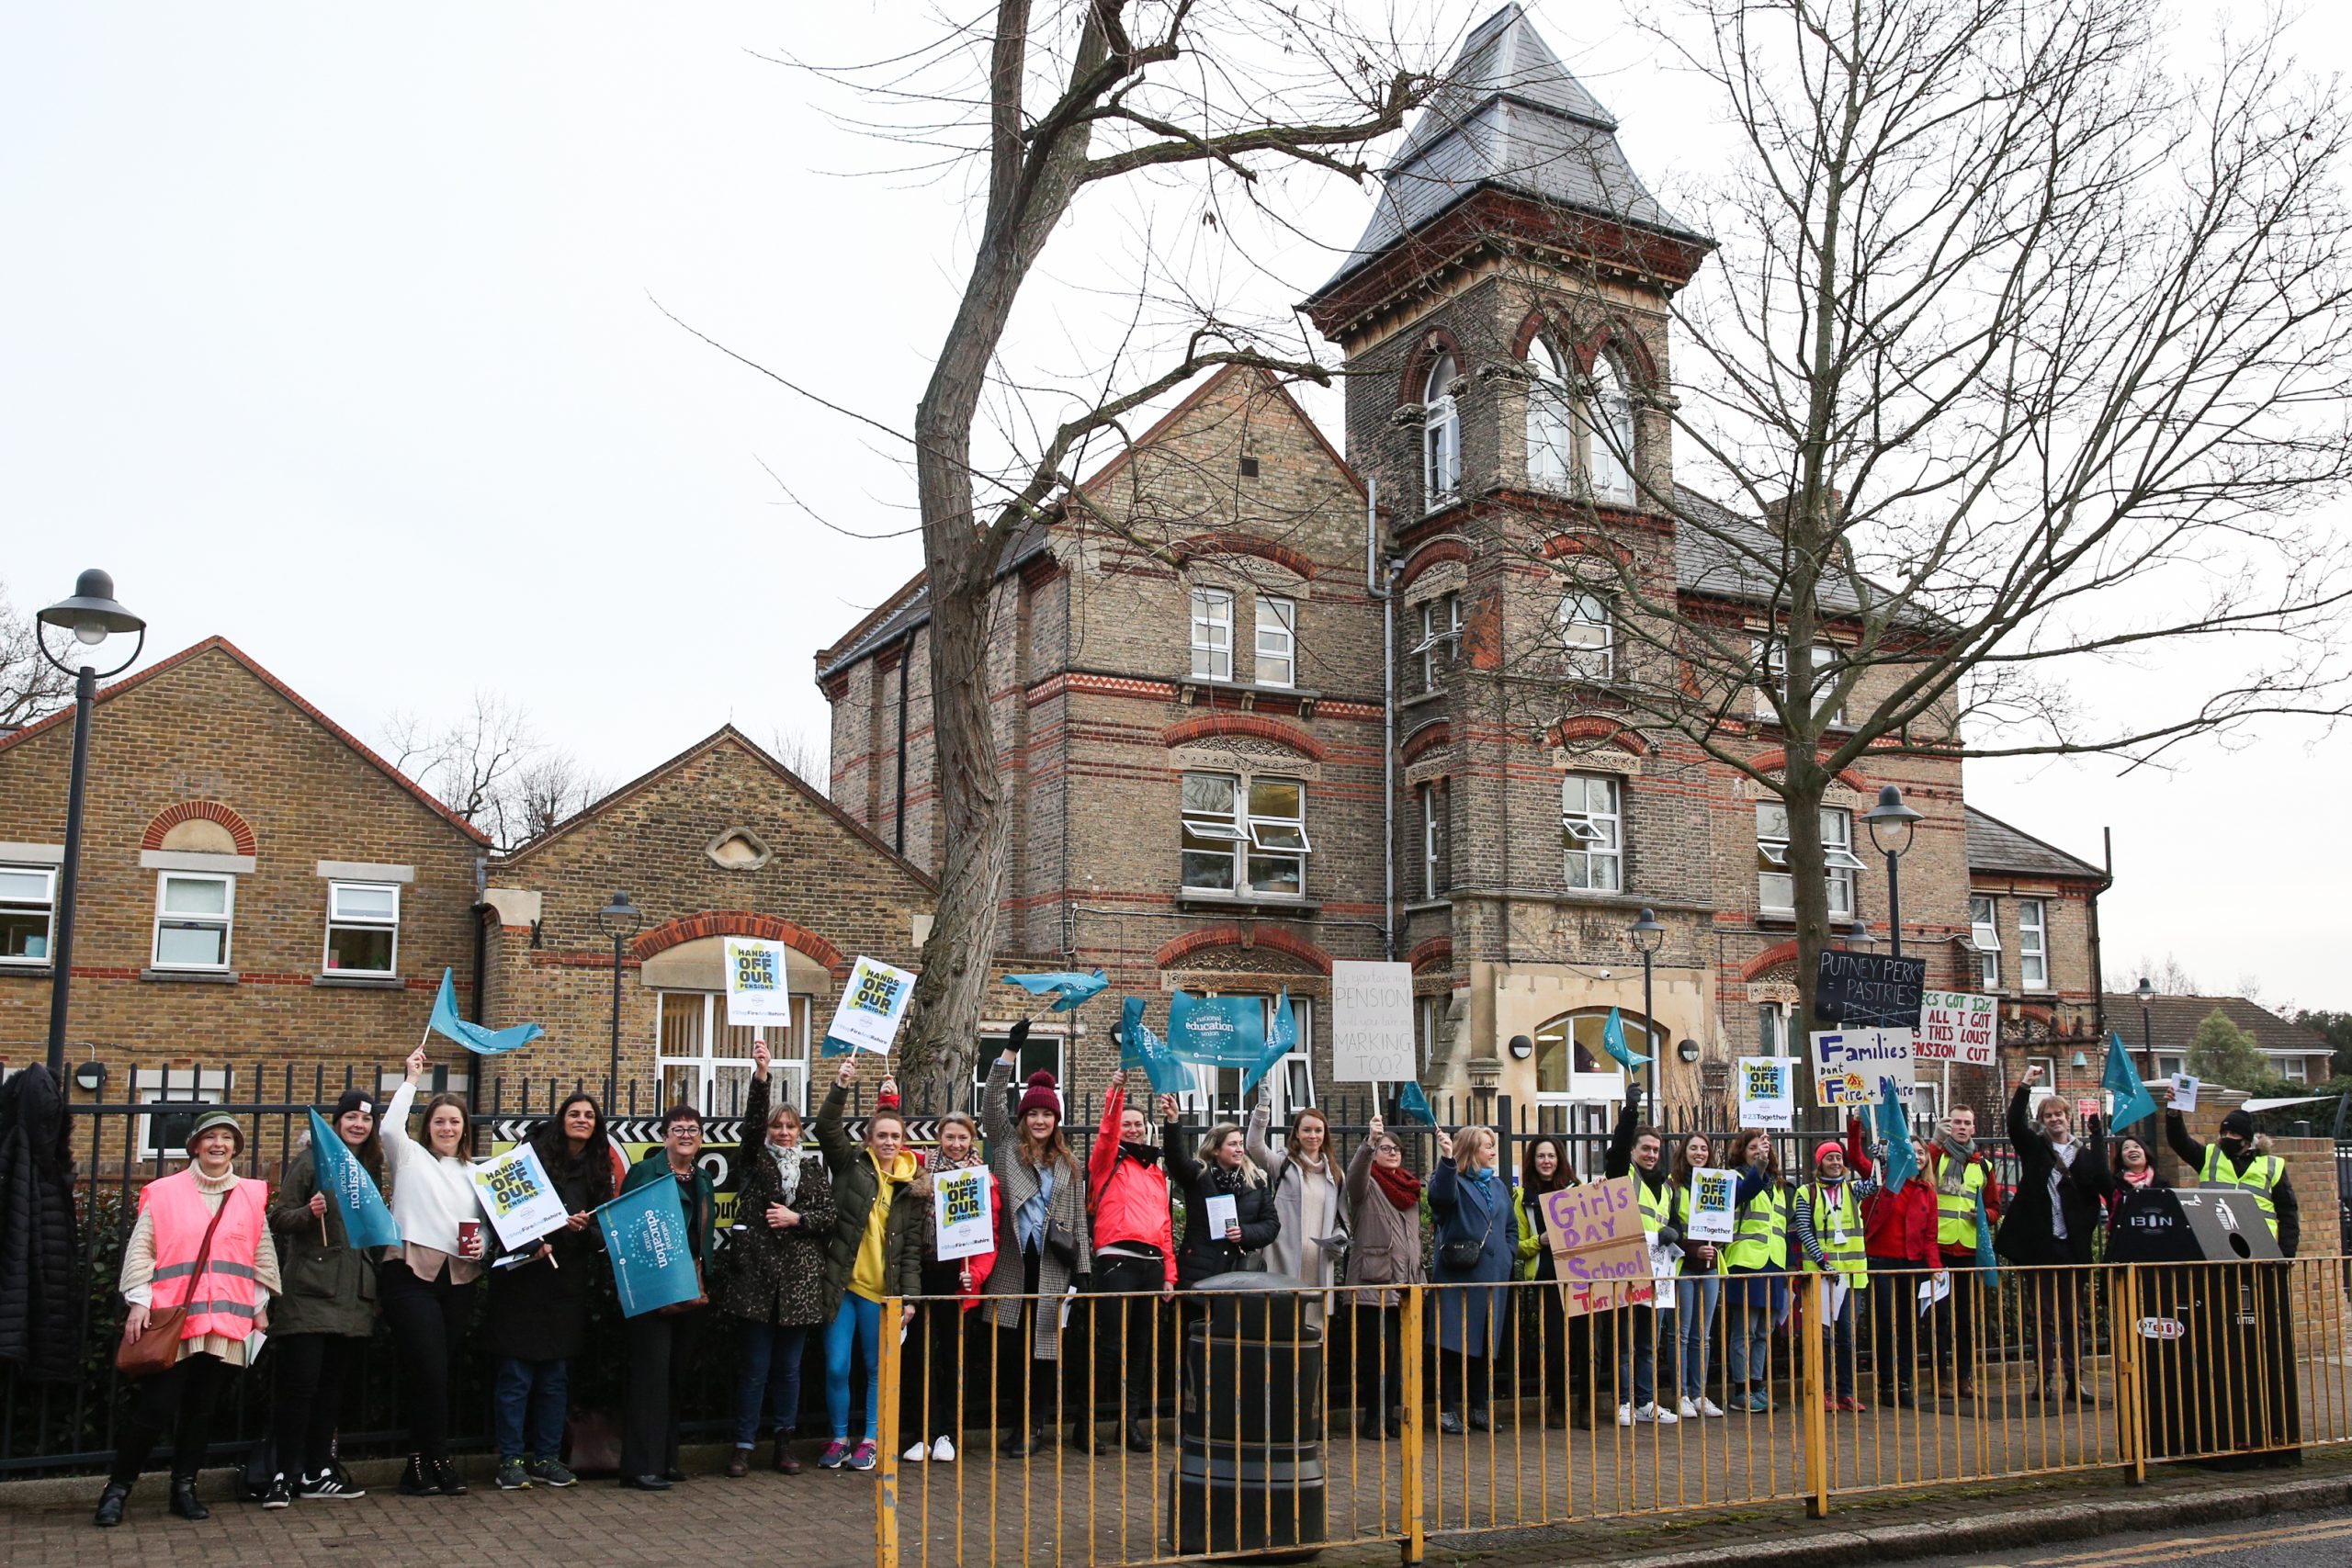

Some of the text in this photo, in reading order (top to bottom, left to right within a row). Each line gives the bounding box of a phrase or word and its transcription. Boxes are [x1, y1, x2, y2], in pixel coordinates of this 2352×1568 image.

[738, 949, 772, 957] HANDS
[739, 957, 772, 971] OFF
[1821, 952, 1926, 984] PUTNEY PERKS
[739, 970, 774, 983] OUR
[865, 970, 900, 987] HANDS
[1352, 974, 1370, 987] you
[1371, 968, 1391, 983] take
[1393, 976, 1407, 987] my
[863, 977, 897, 998] OFF
[1847, 979, 1917, 1006] PASTRIES
[858, 990, 892, 1010] OUR
[1336, 987, 1409, 1009] PENSION
[1945, 994, 1966, 1009] GOT
[1972, 998, 1992, 1012] 12%
[854, 1001, 888, 1016] PENSIONS
[1185, 1021, 1234, 1032] education
[1928, 1010, 1992, 1029] ALL I GOT
[1334, 1032, 1411, 1053] MARKING
[1928, 1025, 1953, 1041] THIS
[1961, 1029, 1992, 1045] LOUSY
[1819, 1032, 1907, 1063] Families
[1966, 1047, 1990, 1062] CUT
[1354, 1053, 1402, 1075] TOO?
[1750, 1073, 1779, 1082] OFF
[1750, 1084, 1779, 1093] OUR
[1825, 1079, 1863, 1103] Fire
[1880, 1075, 1914, 1097] Rhire
[1742, 1113, 1788, 1122] #23Together
[485, 1159, 524, 1181] HANDS
[491, 1167, 527, 1192] OFF
[497, 1179, 536, 1203] OUR
[946, 1178, 978, 1189] HANDS
[1702, 1184, 1727, 1195] OFF
[502, 1190, 539, 1211] PENSIONS
[948, 1186, 978, 1202] OFF
[1700, 1195, 1725, 1205] OUR
[948, 1200, 979, 1215] OUR
[1549, 1185, 1628, 1229] Girls
[948, 1213, 979, 1222] PENSIONS
[645, 1209, 669, 1269] education
[660, 1222, 674, 1251] national
[1564, 1216, 1615, 1248] DAY
[1690, 1225, 1731, 1235] #23Together
[642, 1230, 652, 1252] union
[1567, 1249, 1645, 1291] School
[2236, 1316, 2256, 1325] LTTER
